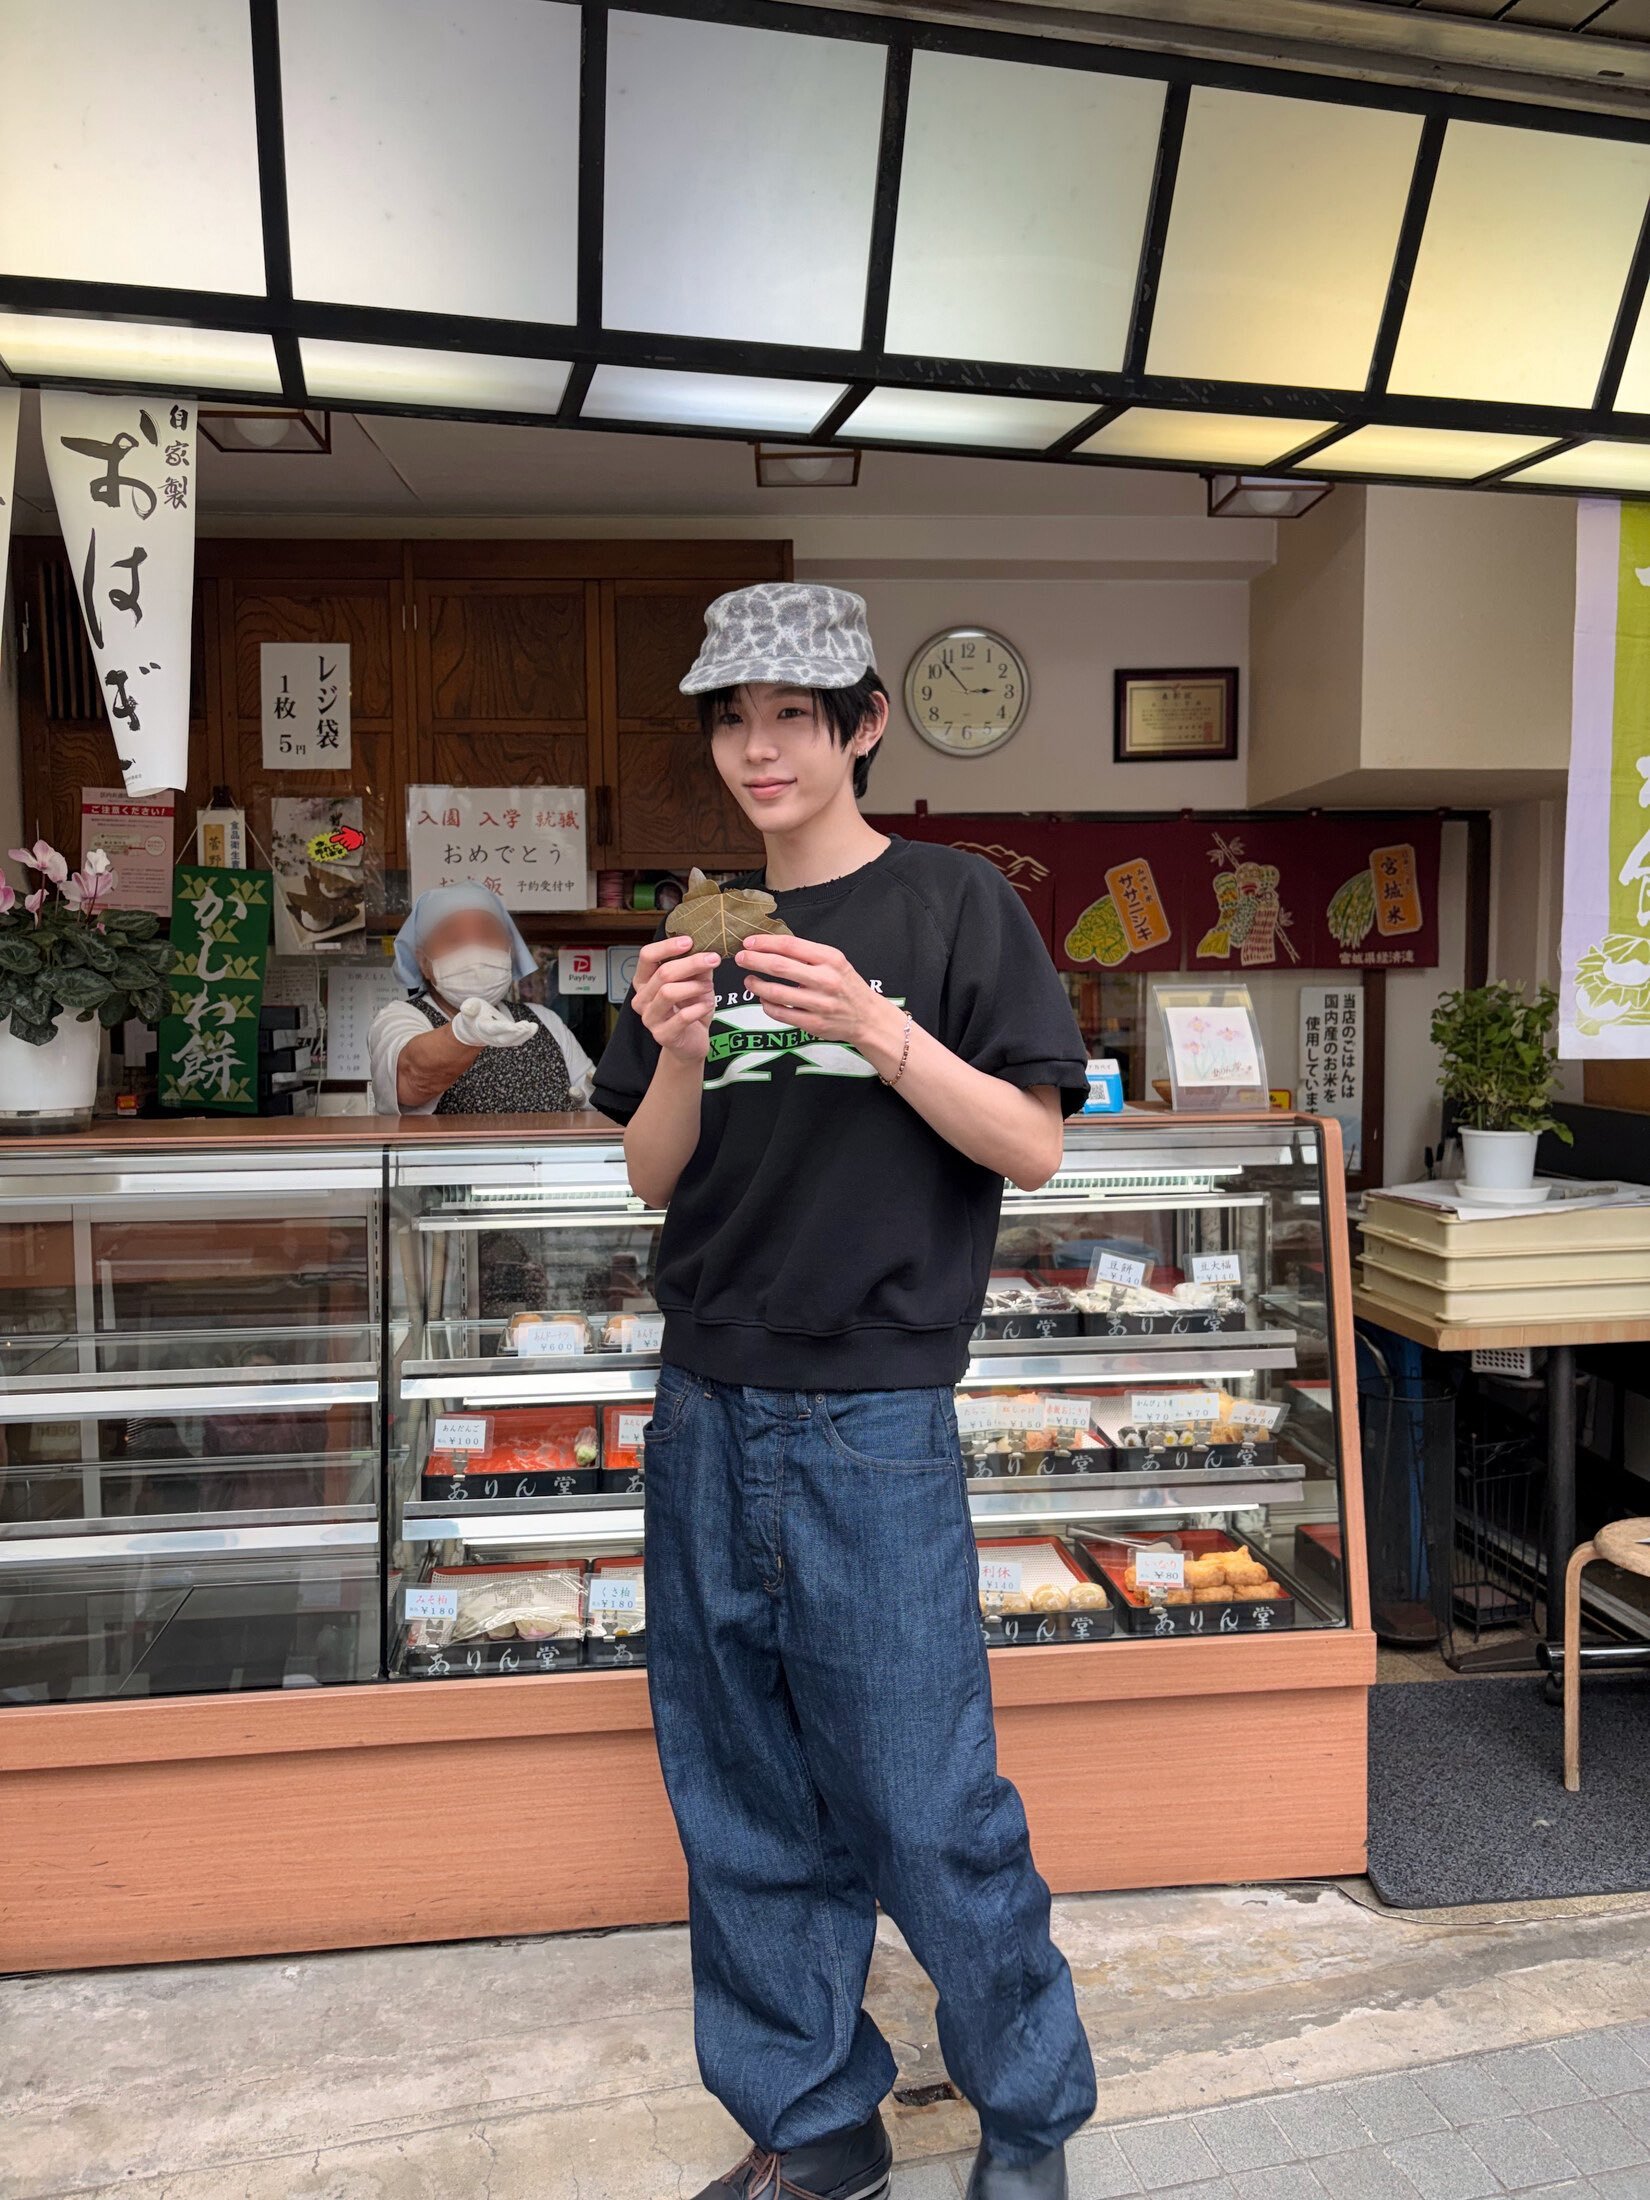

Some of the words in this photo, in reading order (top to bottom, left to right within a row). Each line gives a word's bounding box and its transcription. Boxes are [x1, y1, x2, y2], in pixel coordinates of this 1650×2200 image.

[158, 404, 190, 510] 自家製
[943, 648, 953, 664] 11
[961, 642, 976, 659] 12
[986, 648, 991, 663] 1
[928, 664, 942, 679] 10
[998, 663, 1008, 678] 2
[921, 685, 932, 701] 9
[1003, 683, 1014, 699] 3
[316, 656, 340, 750] レジ袋
[928, 706, 939, 721] 8
[995, 705, 1005, 719] 4
[943, 721, 953, 736] 7
[961, 724, 972, 740] 6
[984, 721, 992, 735] 5
[417, 807, 461, 828] 入園
[478, 808, 521, 829] 入学
[535, 810, 580, 830] 就職
[443, 843, 561, 865] おめでとう
[516, 880, 575, 893] 予約受付中
[1380, 855, 1406, 925] 宮城米
[1118, 873, 1153, 941] ササニシキ
[568, 973, 597, 983] PayPay
[171, 886, 248, 1098] かしわ餅
[1323, 993, 1339, 1103] 国内産のお米を
[1341, 993, 1356, 1099] 当店のごはんは
[1200, 1259, 1232, 1272] 豆大福
[973, 1318, 1057, 1339] りん堂
[1108, 1315, 1226, 1336] ありん堂
[541, 1343, 573, 1351] ¥600
[443, 1424, 480, 1432] あんだんご
[449, 1436, 480, 1445] ¥100
[973, 1454, 1094, 1479] ありん堂
[1141, 1448, 1258, 1471] ありん堂
[447, 1475, 577, 1500] ありん堂
[981, 1565, 1012, 1579] 利休
[1154, 1571, 1179, 1580] ¥80
[987, 1580, 1014, 1589] ¥140
[421, 1606, 455, 1615] ¥180
[601, 1599, 634, 1608] ¥180
[1155, 1605, 1275, 1635] ありん堂
[427, 1646, 560, 1676] ありん堂
